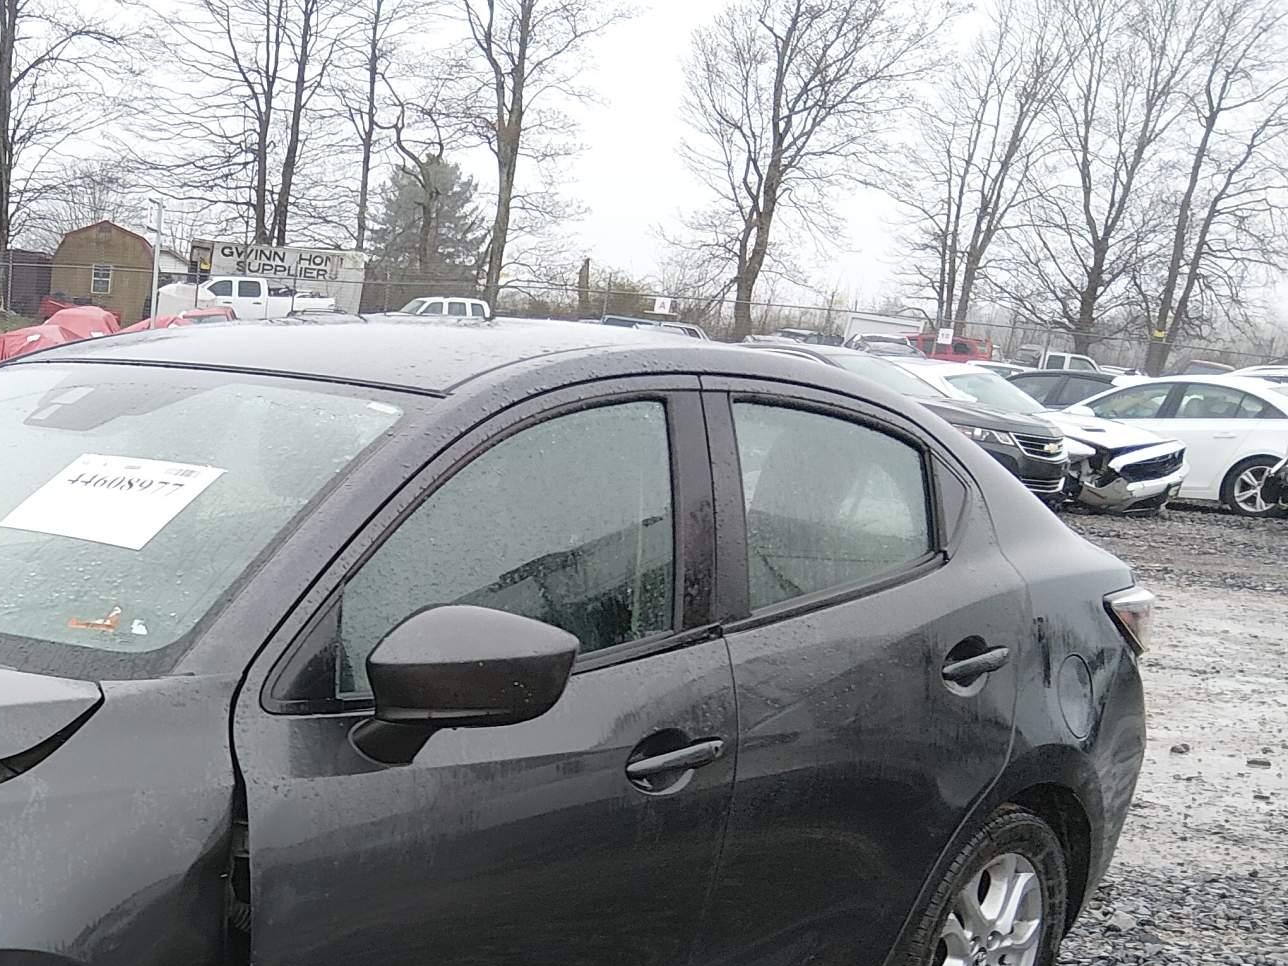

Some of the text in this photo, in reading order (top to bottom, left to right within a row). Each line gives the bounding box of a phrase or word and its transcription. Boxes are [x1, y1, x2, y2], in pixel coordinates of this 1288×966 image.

[220, 246, 344, 268] GWINN HO
[67, 473, 185, 496] 44608977
